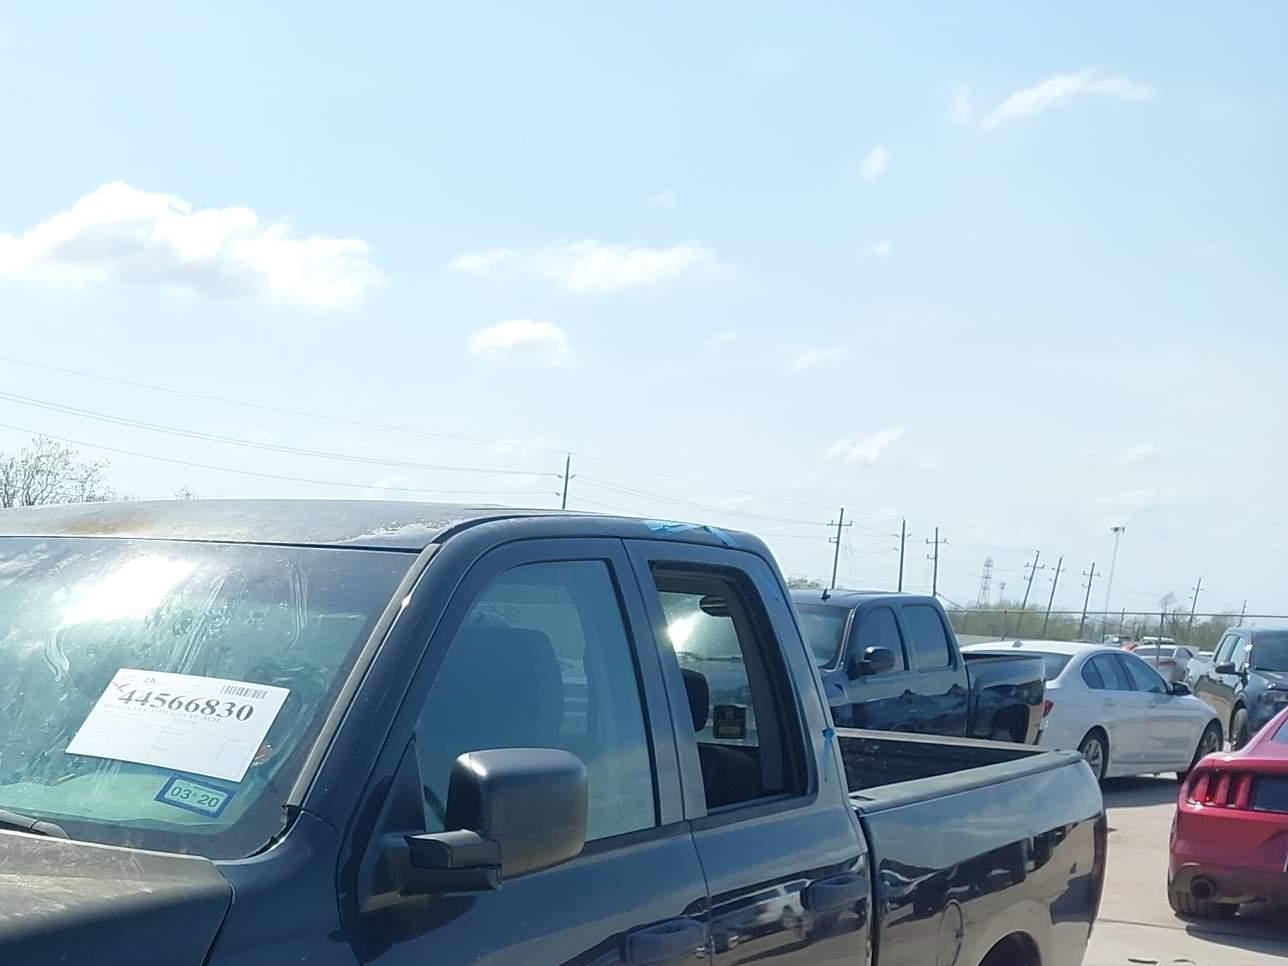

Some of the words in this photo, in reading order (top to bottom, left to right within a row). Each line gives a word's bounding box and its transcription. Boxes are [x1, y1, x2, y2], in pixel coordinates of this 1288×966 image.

[117, 689, 255, 722] 44566830
[170, 786, 192, 800] 03
[197, 794, 220, 808] 20
